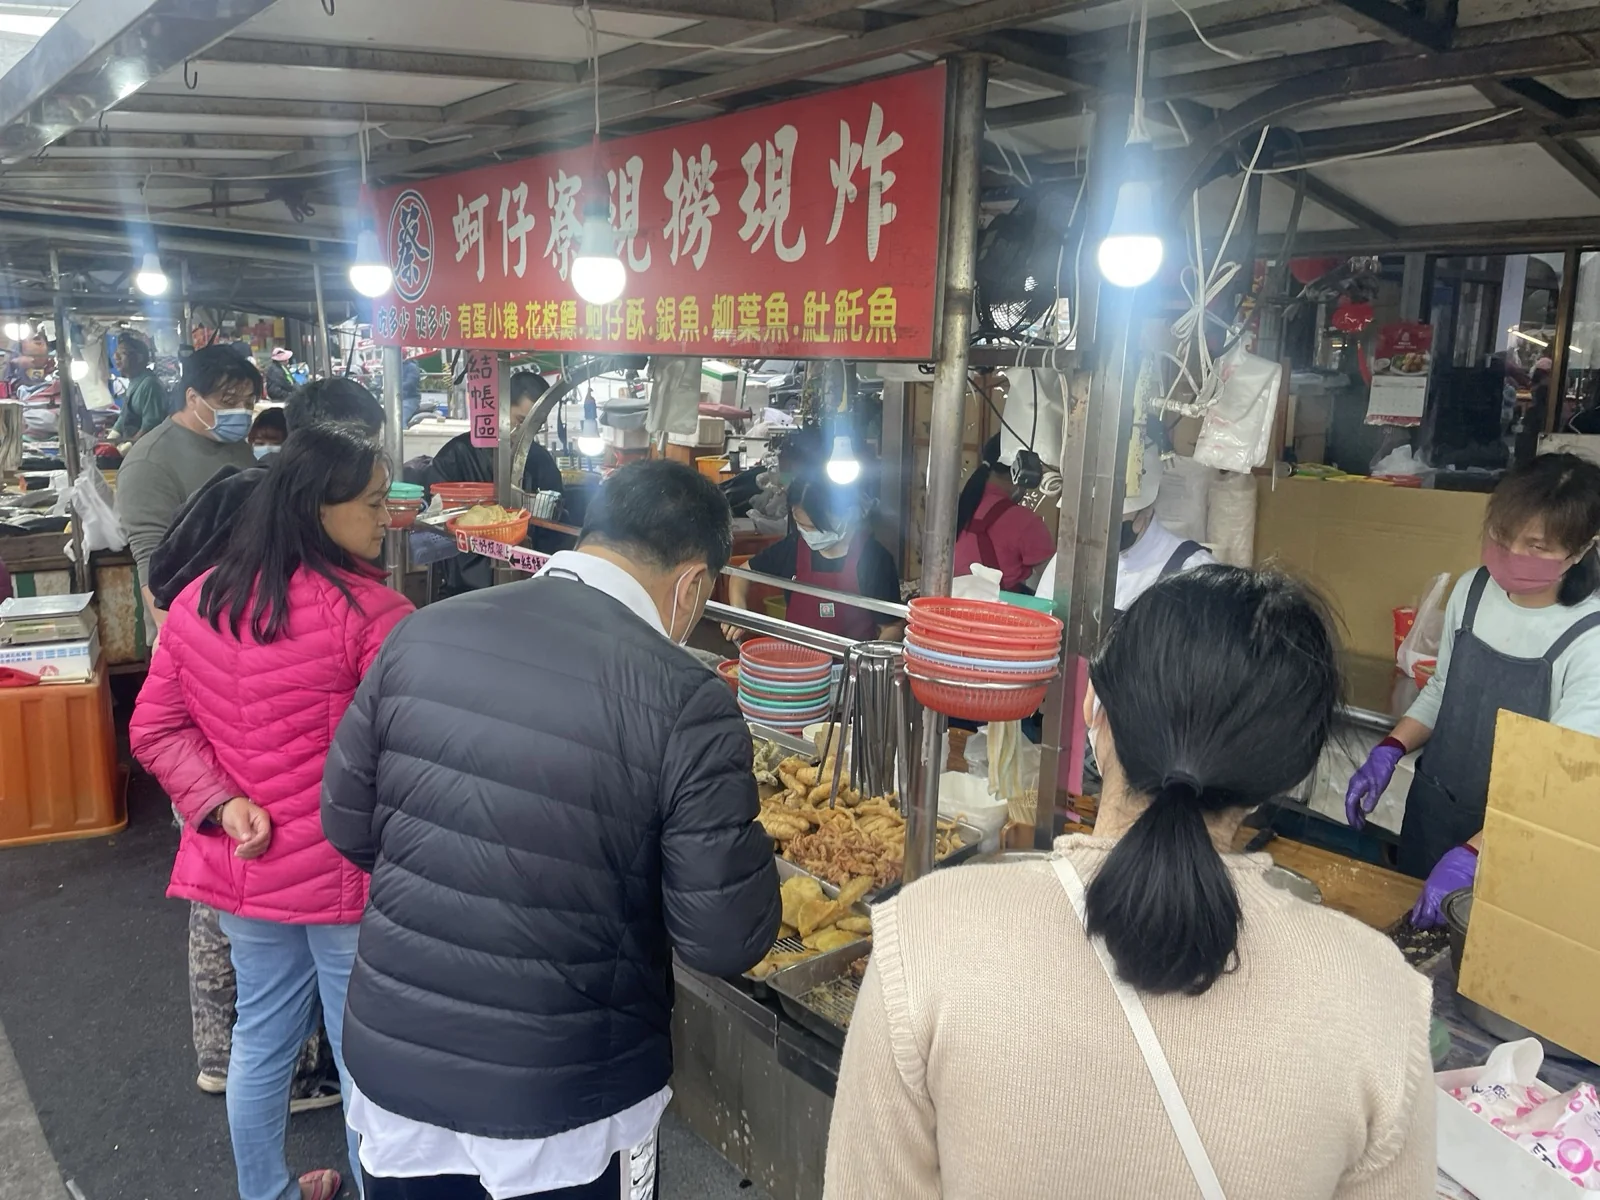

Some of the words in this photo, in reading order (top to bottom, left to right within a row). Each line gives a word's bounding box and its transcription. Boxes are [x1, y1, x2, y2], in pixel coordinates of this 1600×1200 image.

[395, 203, 430, 288] 蔡
[469, 354, 497, 439] 結帳區
